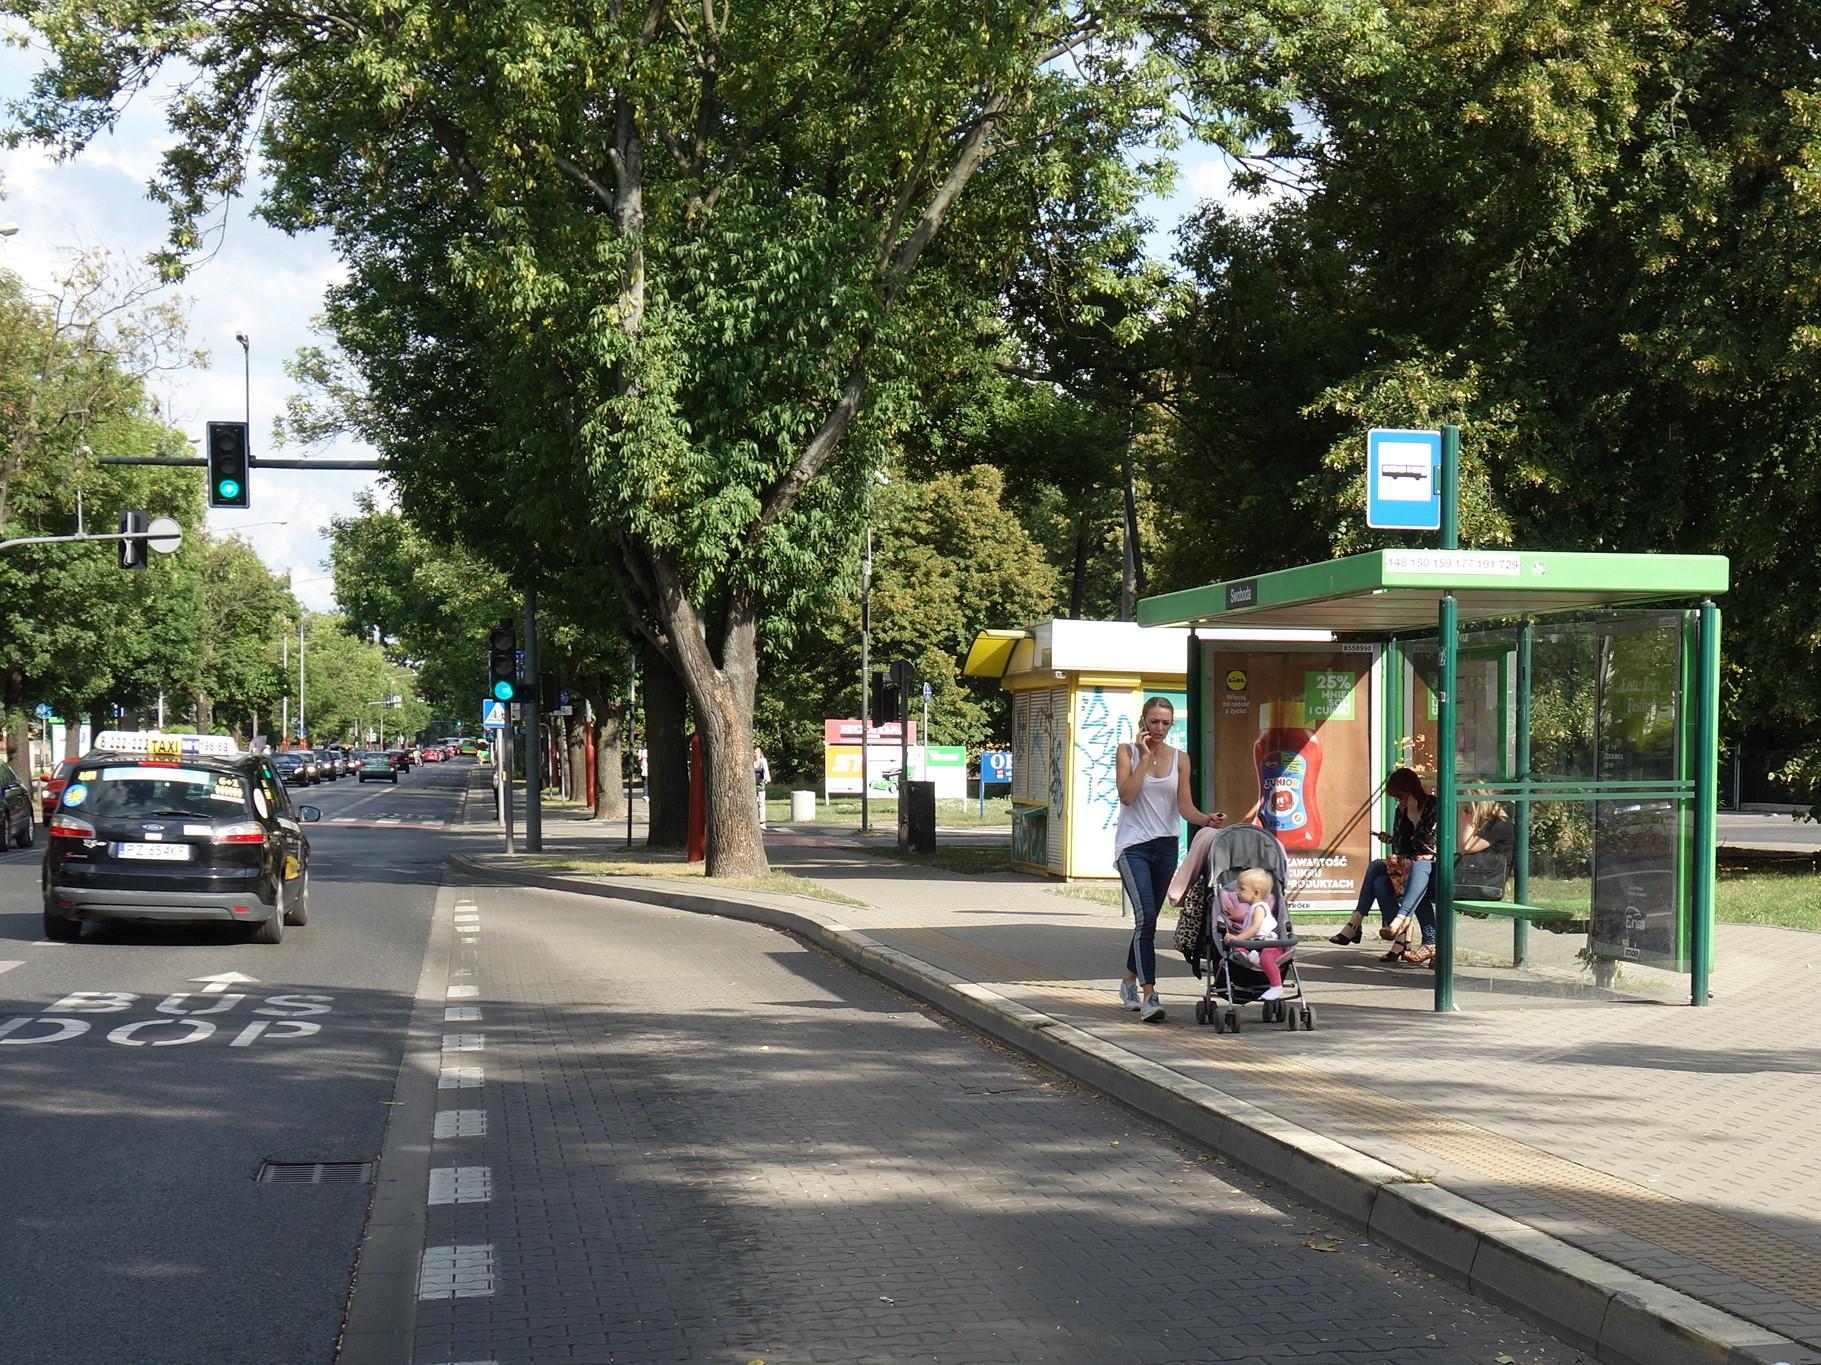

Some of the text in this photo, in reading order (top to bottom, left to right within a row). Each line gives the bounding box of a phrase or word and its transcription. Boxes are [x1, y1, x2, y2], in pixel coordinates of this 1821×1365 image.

[1388, 558, 1518, 570] 148 150 159 177 191 729
[1230, 586, 1252, 603] Swoboda
[1316, 675, 1351, 690] 25%
[152, 739, 179, 753] TAXI
[1264, 778, 1299, 788] JUNIOR
[42, 991, 335, 1017] BUS
[0, 1017, 322, 1046] DOP
